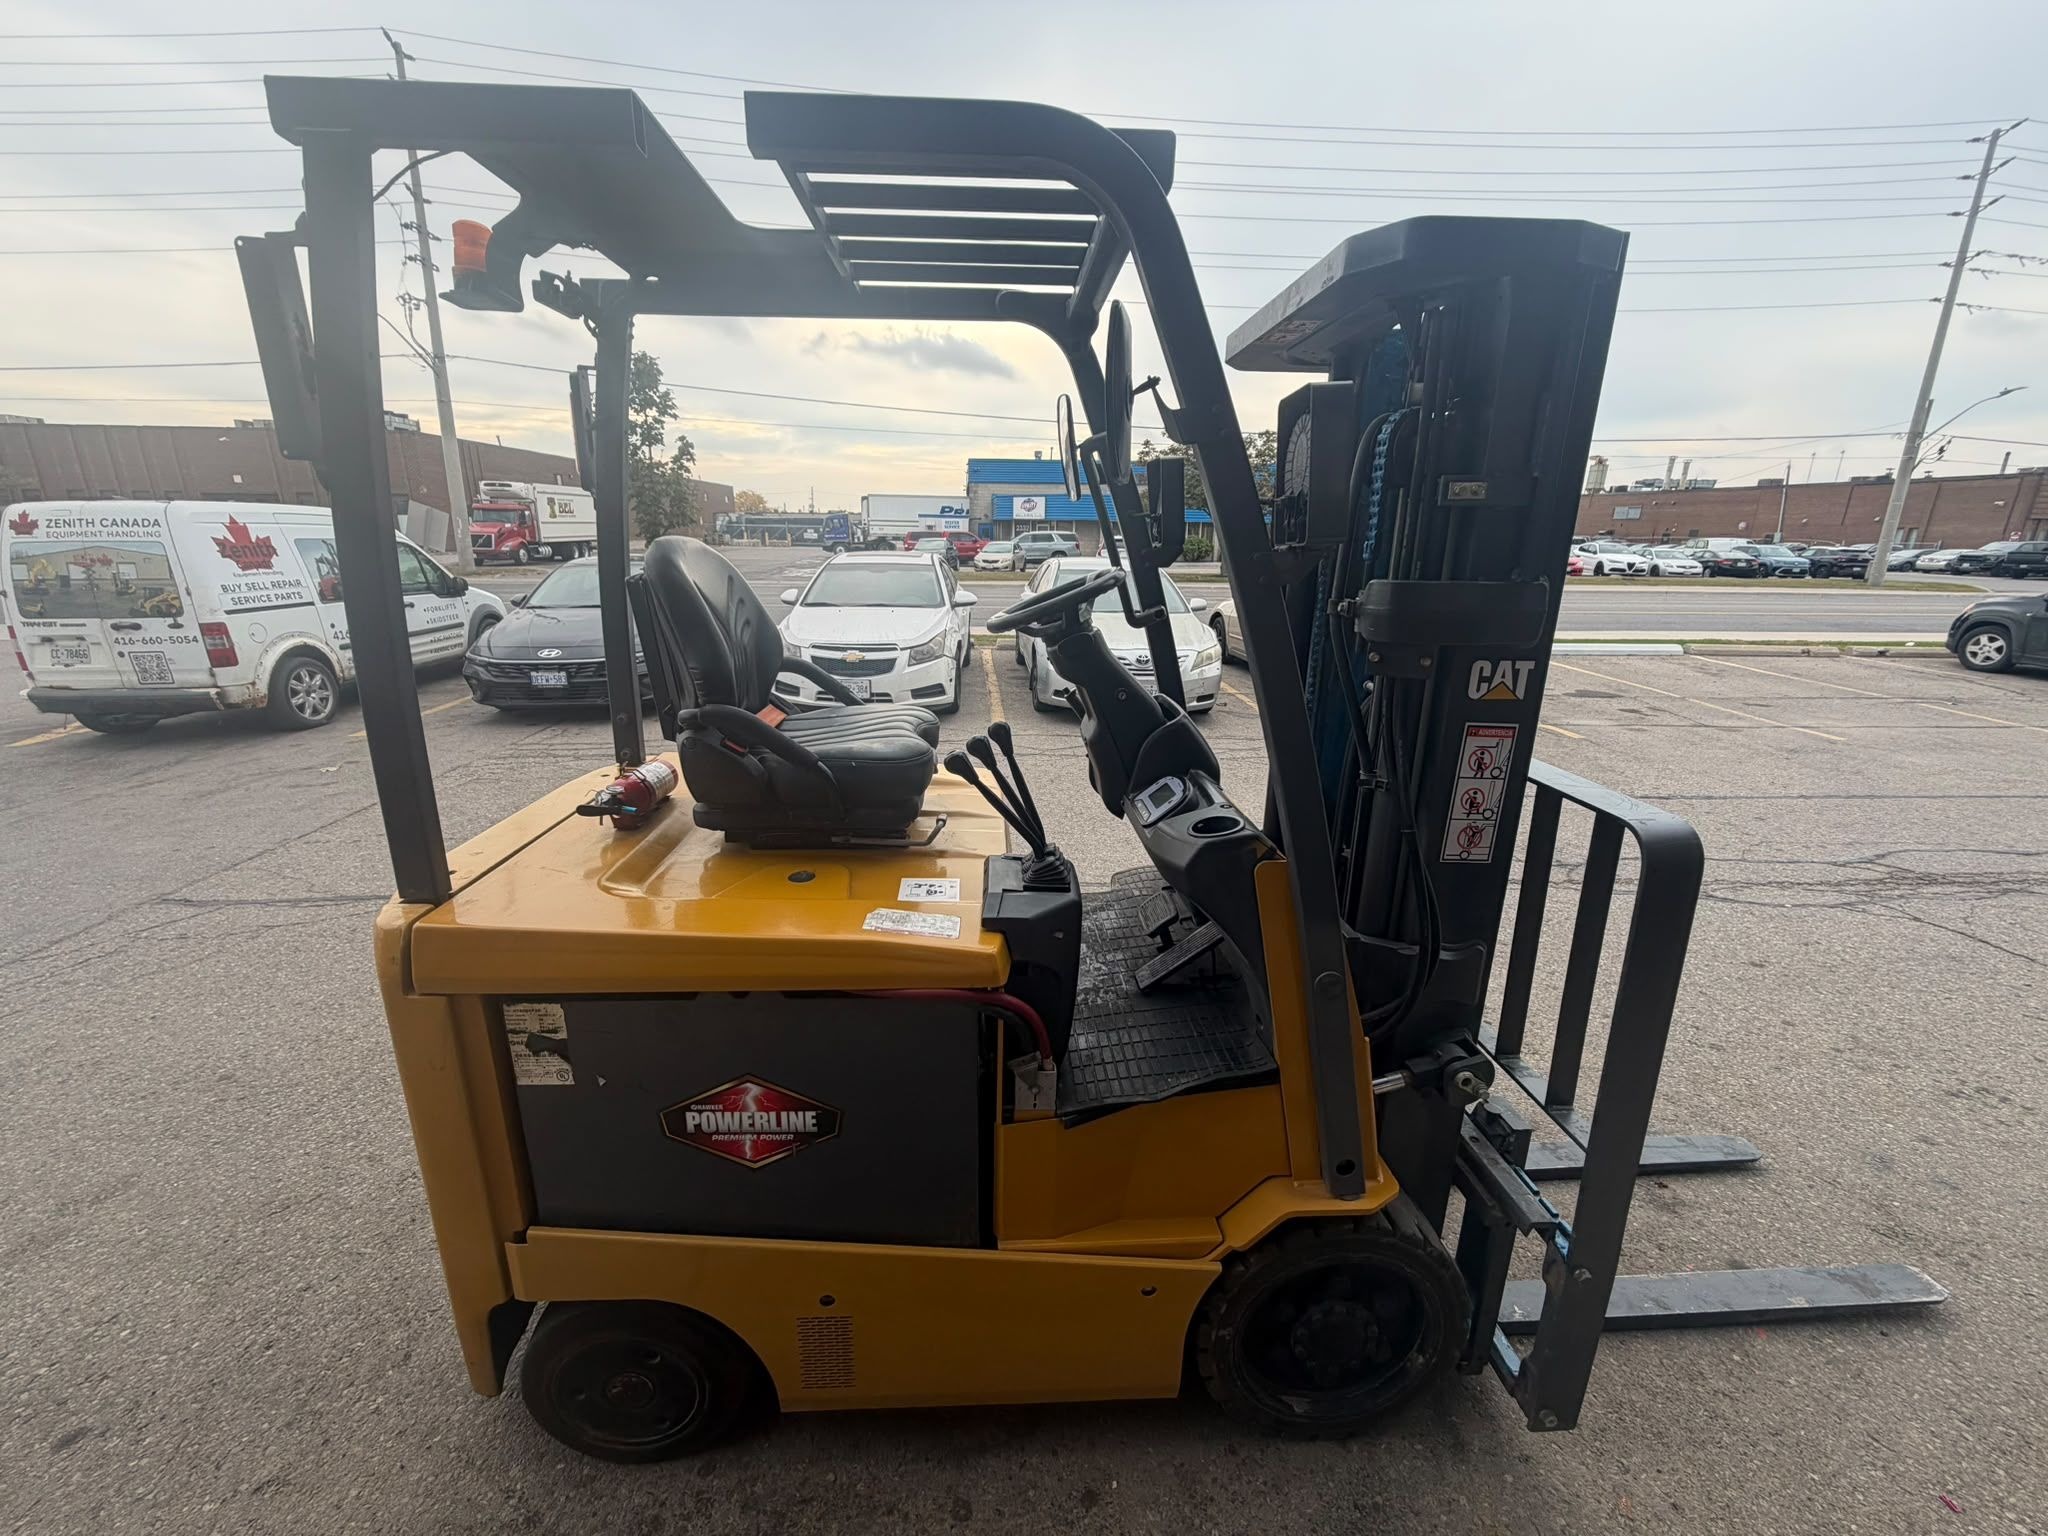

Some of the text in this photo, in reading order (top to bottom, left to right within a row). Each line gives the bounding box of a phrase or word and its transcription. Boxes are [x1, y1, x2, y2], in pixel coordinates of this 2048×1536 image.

[45, 517, 162, 529] ZENITH CANADA
[46, 530, 162, 540] EQUIPMENT HANDLING
[220, 578, 303, 594] BUY SELL REPAIR
[230, 591, 304, 606] SERVICE PARTS
[113, 635, 200, 646] 416-660-5054
[1467, 660, 1536, 700] CAT
[685, 1111, 818, 1134] POWERLINE
